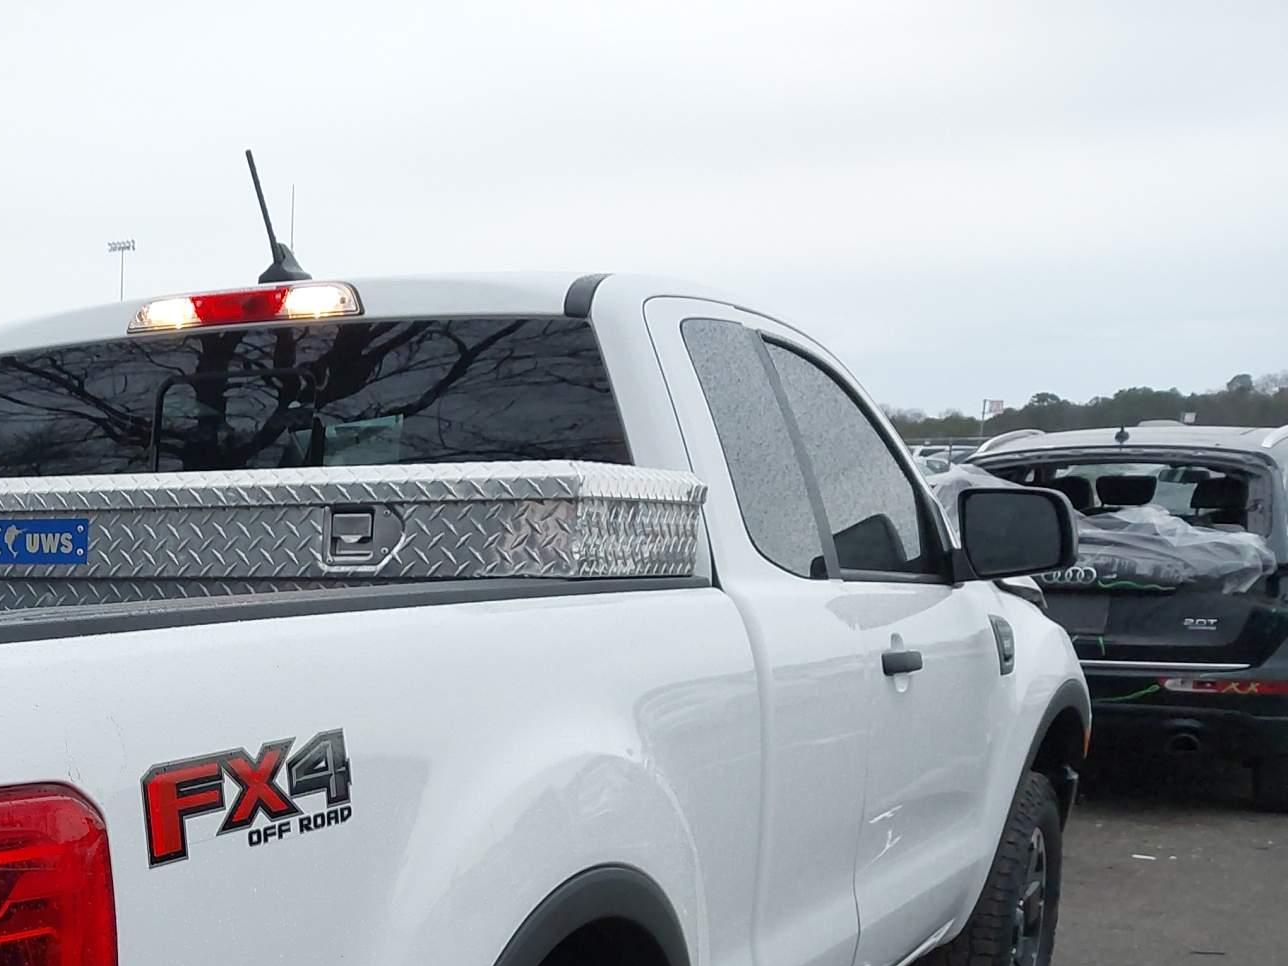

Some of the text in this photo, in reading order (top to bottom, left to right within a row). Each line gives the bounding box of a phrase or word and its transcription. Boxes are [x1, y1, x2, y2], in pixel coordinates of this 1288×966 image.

[26, 533, 73, 554] UWS
[140, 728, 352, 869] FX4
[248, 806, 353, 848] OFF ROAD
